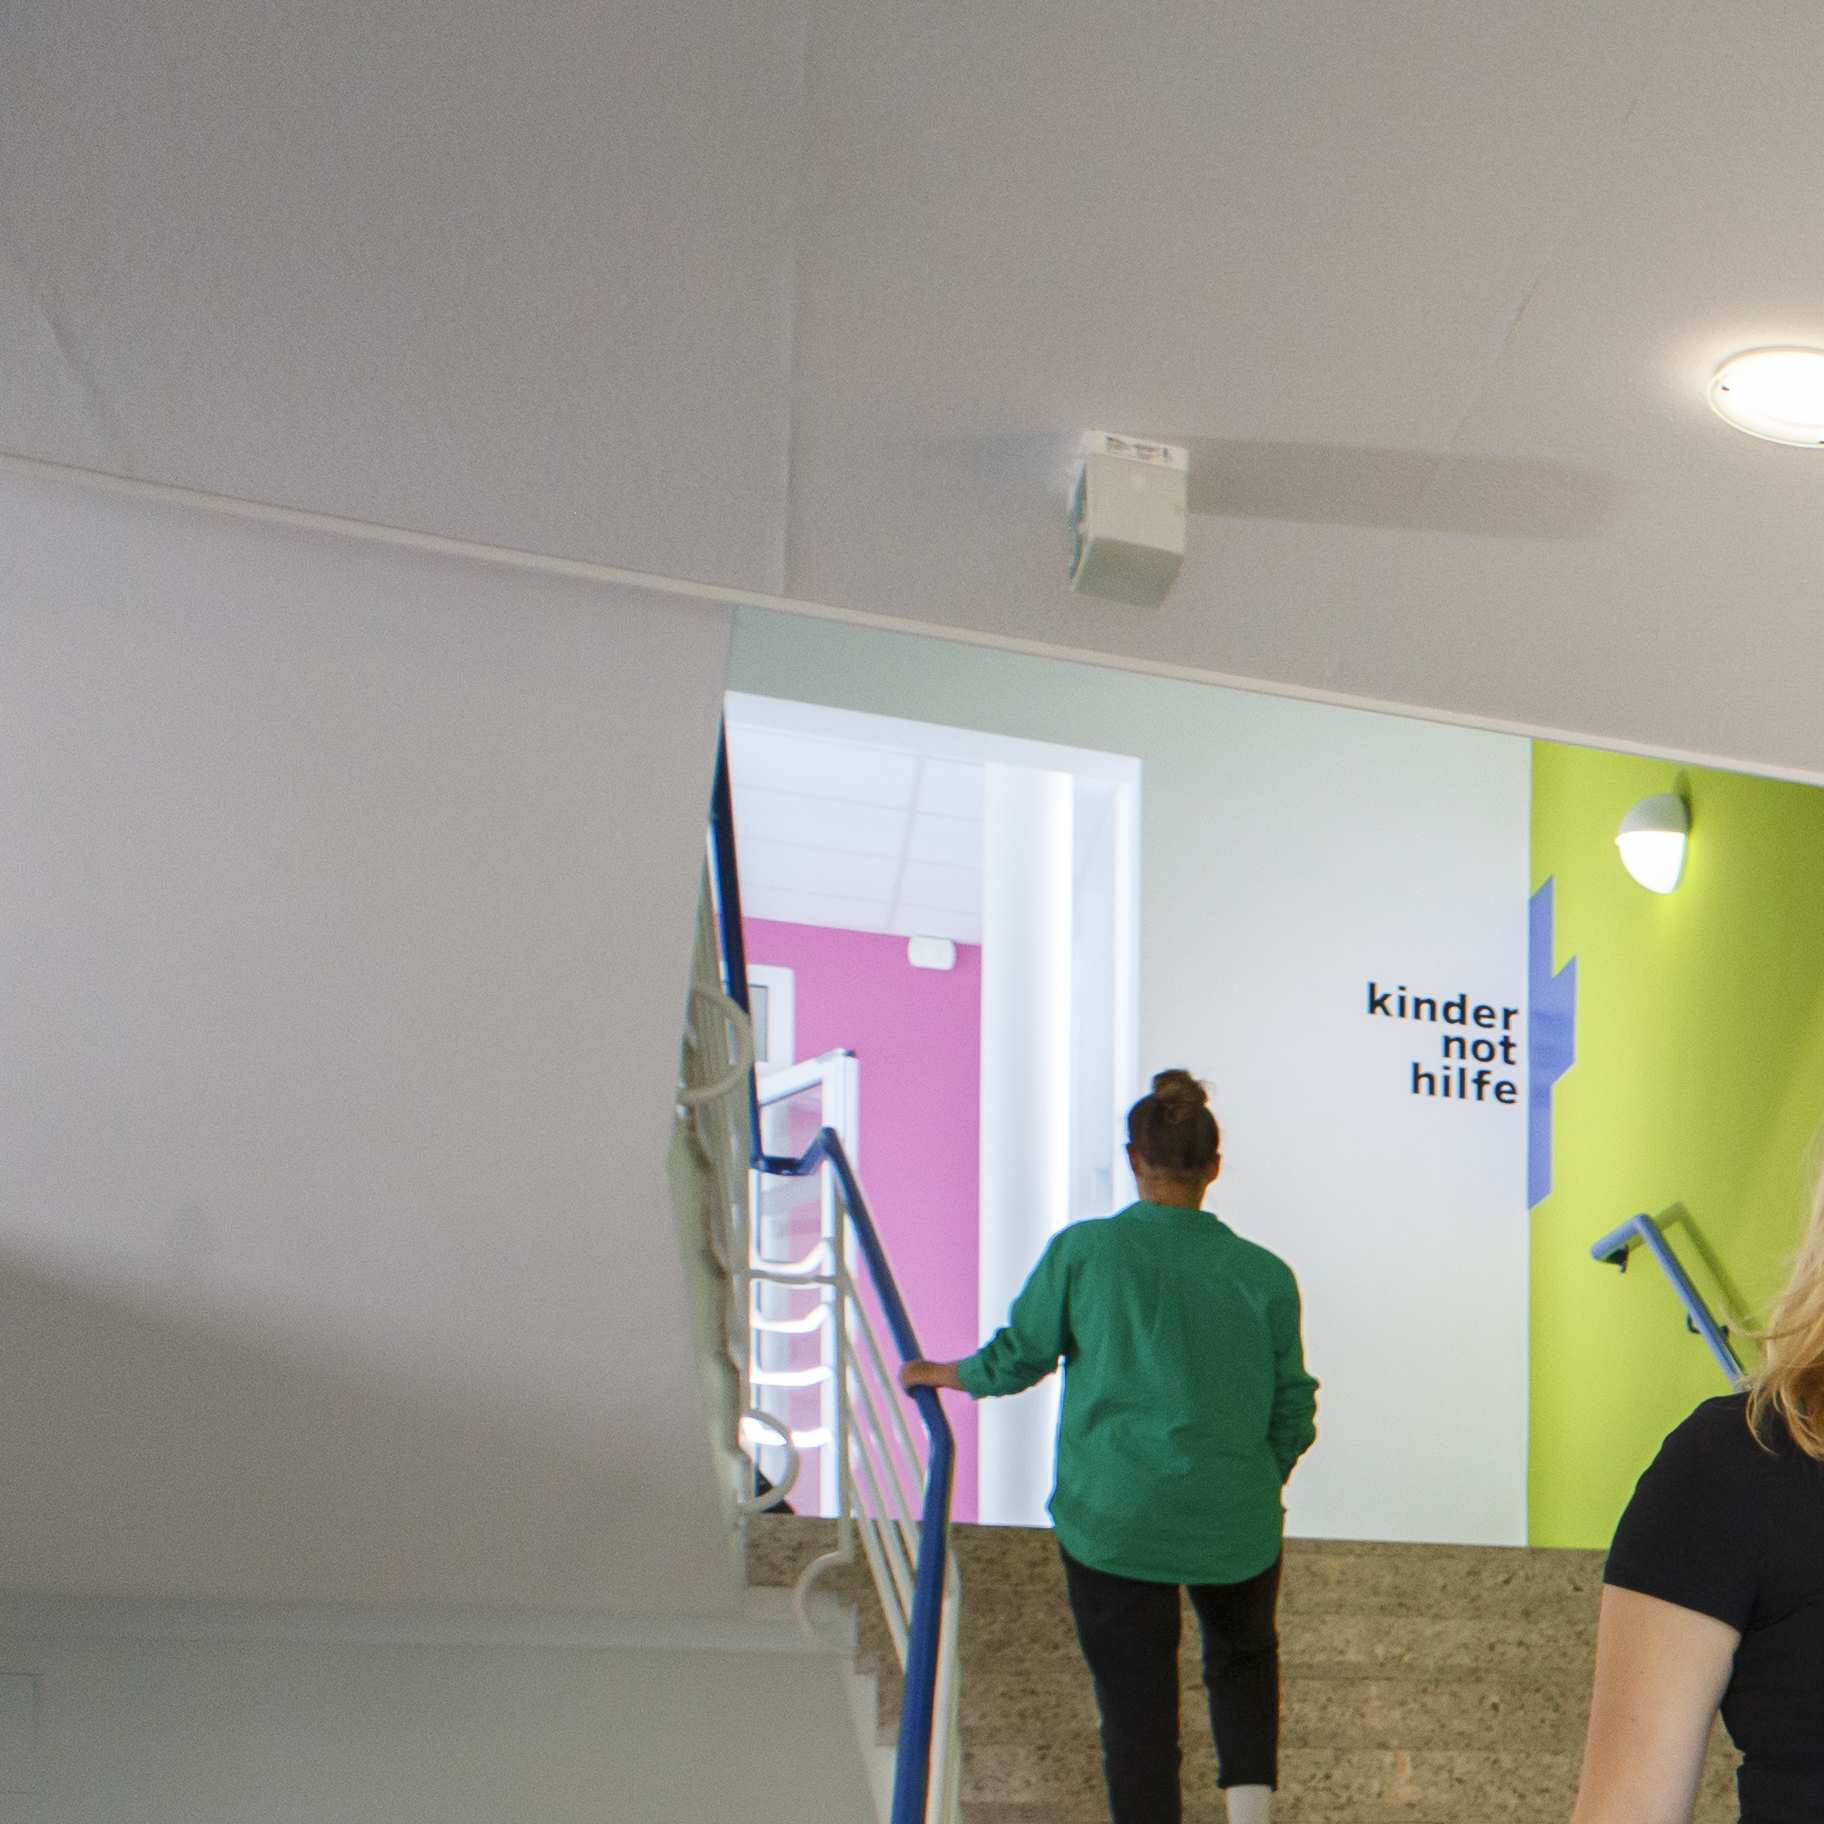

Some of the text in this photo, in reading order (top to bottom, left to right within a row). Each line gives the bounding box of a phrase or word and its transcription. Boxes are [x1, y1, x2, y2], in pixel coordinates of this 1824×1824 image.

[1367, 981, 1519, 1031] kinder
[1442, 1034, 1517, 1066] not
[1411, 1061, 1518, 1105] hilfe
